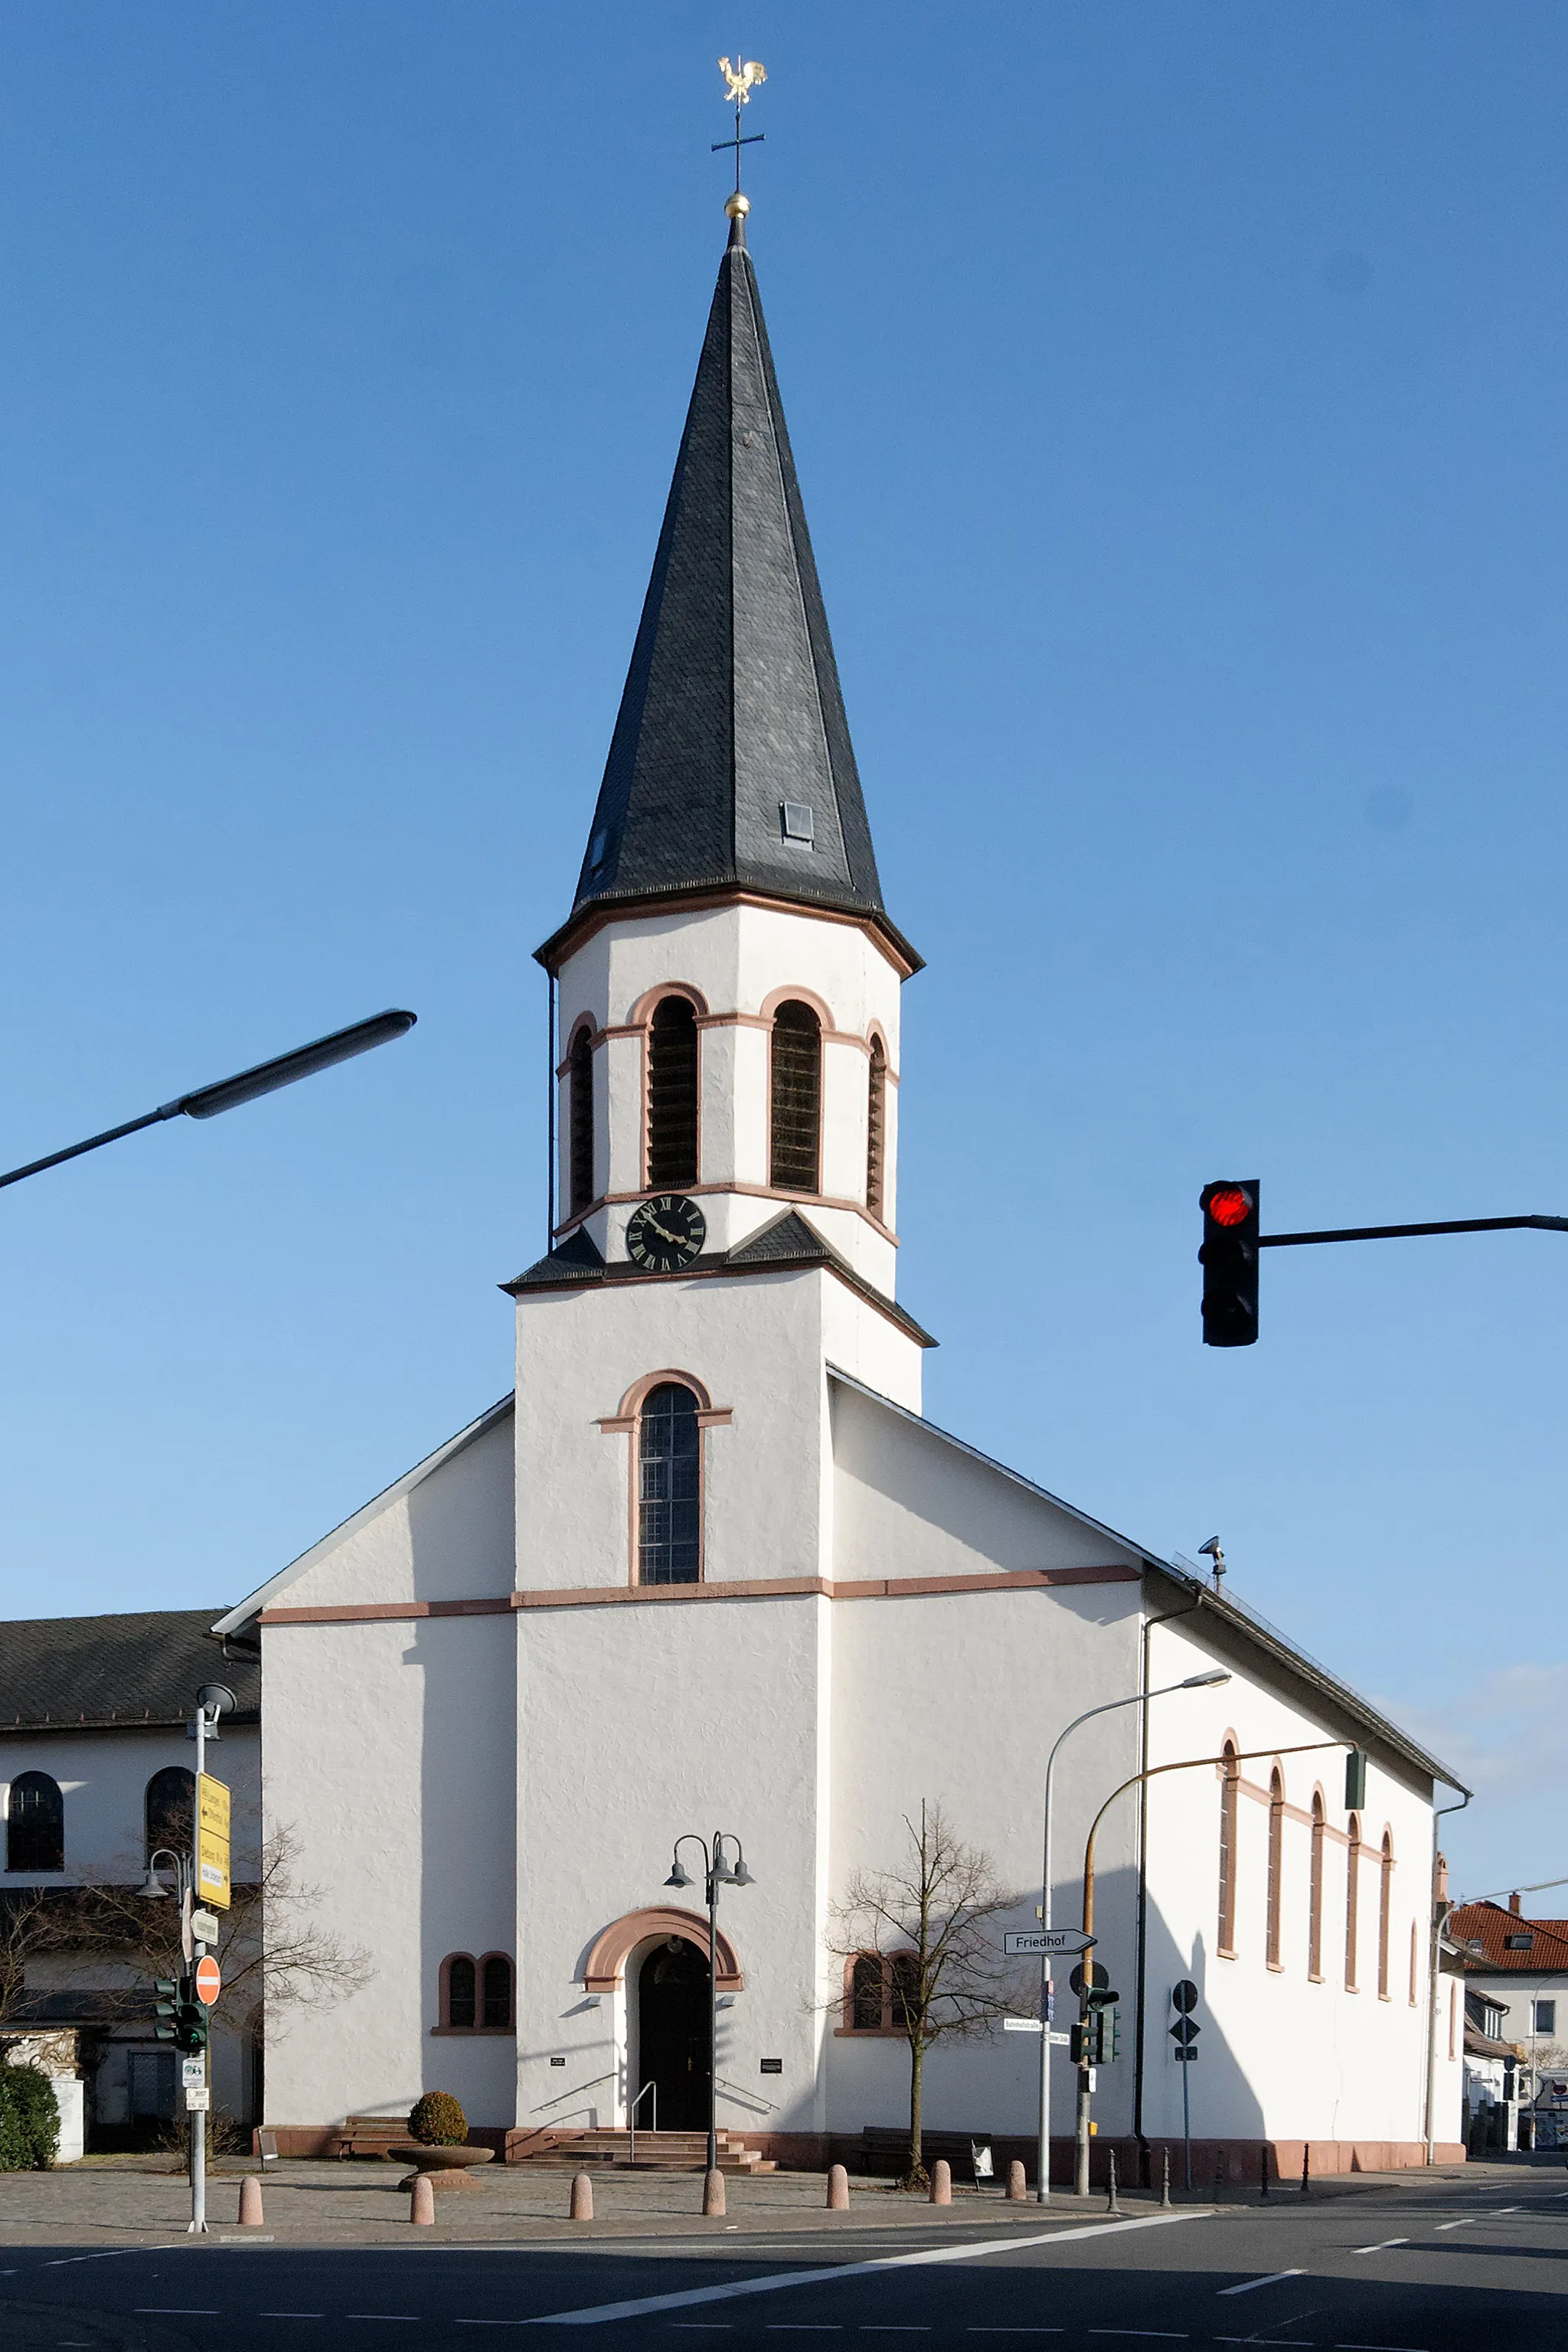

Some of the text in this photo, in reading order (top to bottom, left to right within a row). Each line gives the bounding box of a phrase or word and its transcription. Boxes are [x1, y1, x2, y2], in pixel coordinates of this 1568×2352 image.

[660, 1197, 671, 1211] XII
[678, 1200, 687, 1213] I
[632, 1215, 647, 1227] X
[687, 1211, 700, 1223] II
[629, 1231, 642, 1241] IX
[691, 1227, 704, 1236] III
[661, 1258, 671, 1271] VI
[677, 1253, 688, 1267] V
[1016, 1935, 1066, 1948] Friedhof
